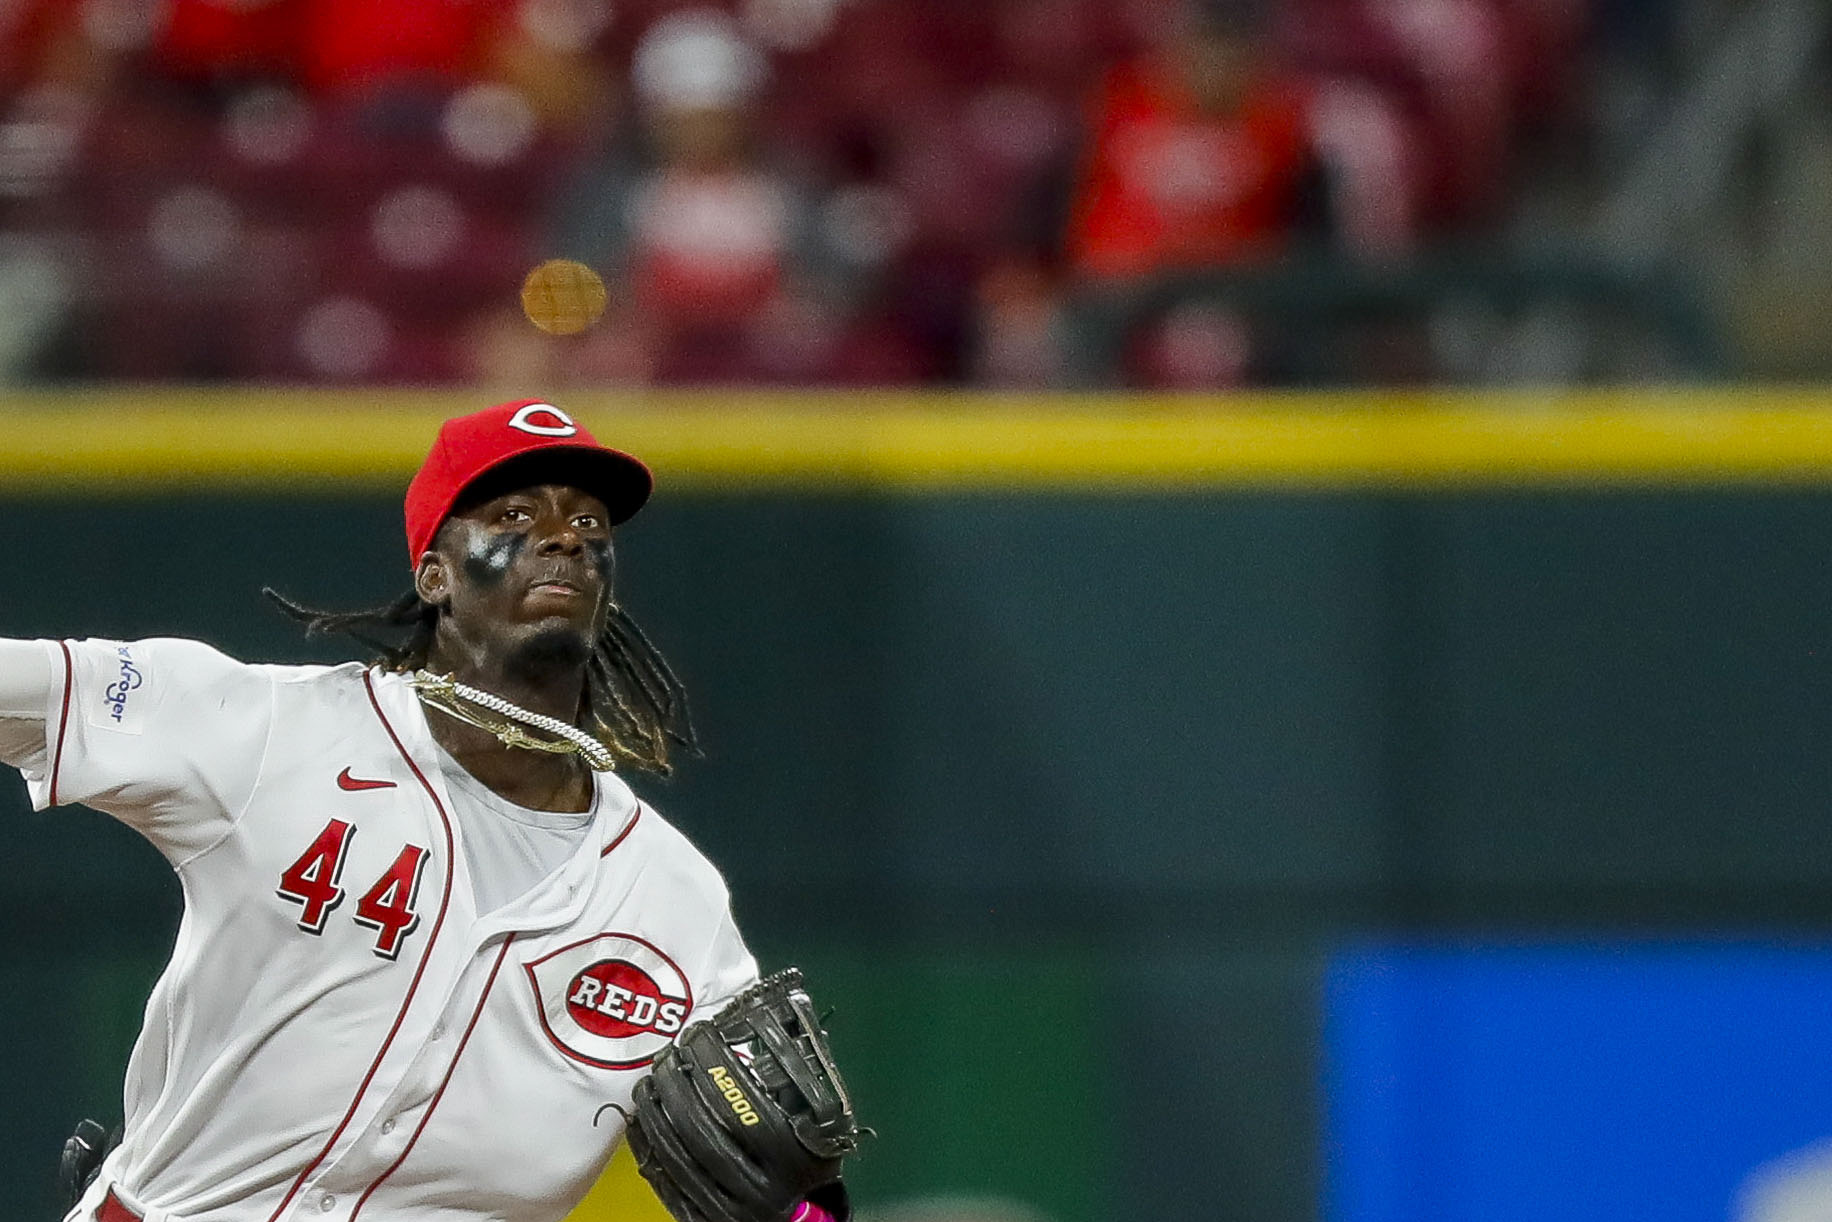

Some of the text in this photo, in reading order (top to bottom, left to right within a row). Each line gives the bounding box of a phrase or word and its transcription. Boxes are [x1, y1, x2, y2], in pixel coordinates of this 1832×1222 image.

[106, 659, 142, 722] Kroger
[275, 817, 431, 961] 44
[569, 975, 689, 1034] REDS
[708, 1065, 760, 1127] A2000
